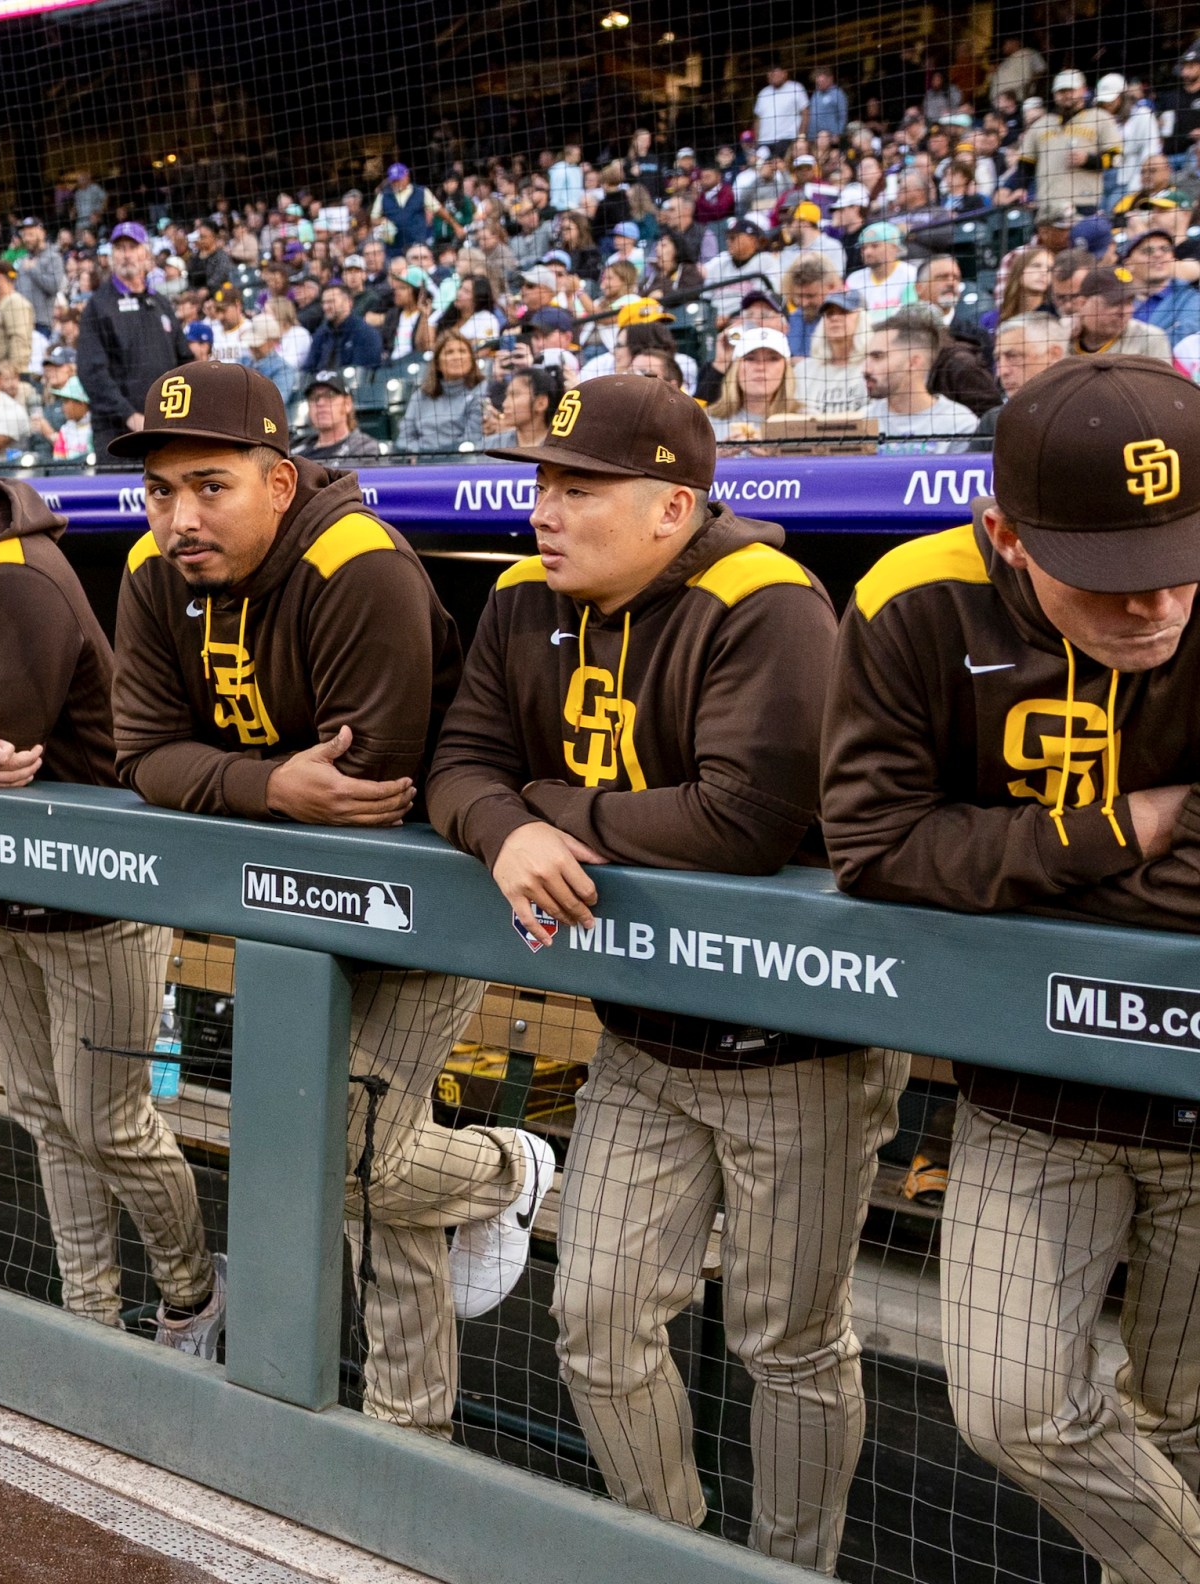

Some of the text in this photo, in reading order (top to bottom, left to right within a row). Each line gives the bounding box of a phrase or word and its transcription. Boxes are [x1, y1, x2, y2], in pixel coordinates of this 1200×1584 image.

[159, 375, 192, 420] SD
[551, 389, 582, 438] SD
[708, 479, 801, 500] w.com
[903, 469, 996, 505] ARR
[1123, 438, 1180, 506] SD
[24, 837, 159, 886] NETWORK
[247, 870, 361, 916] MLB.com
[569, 915, 899, 998] MLB NETWORK
